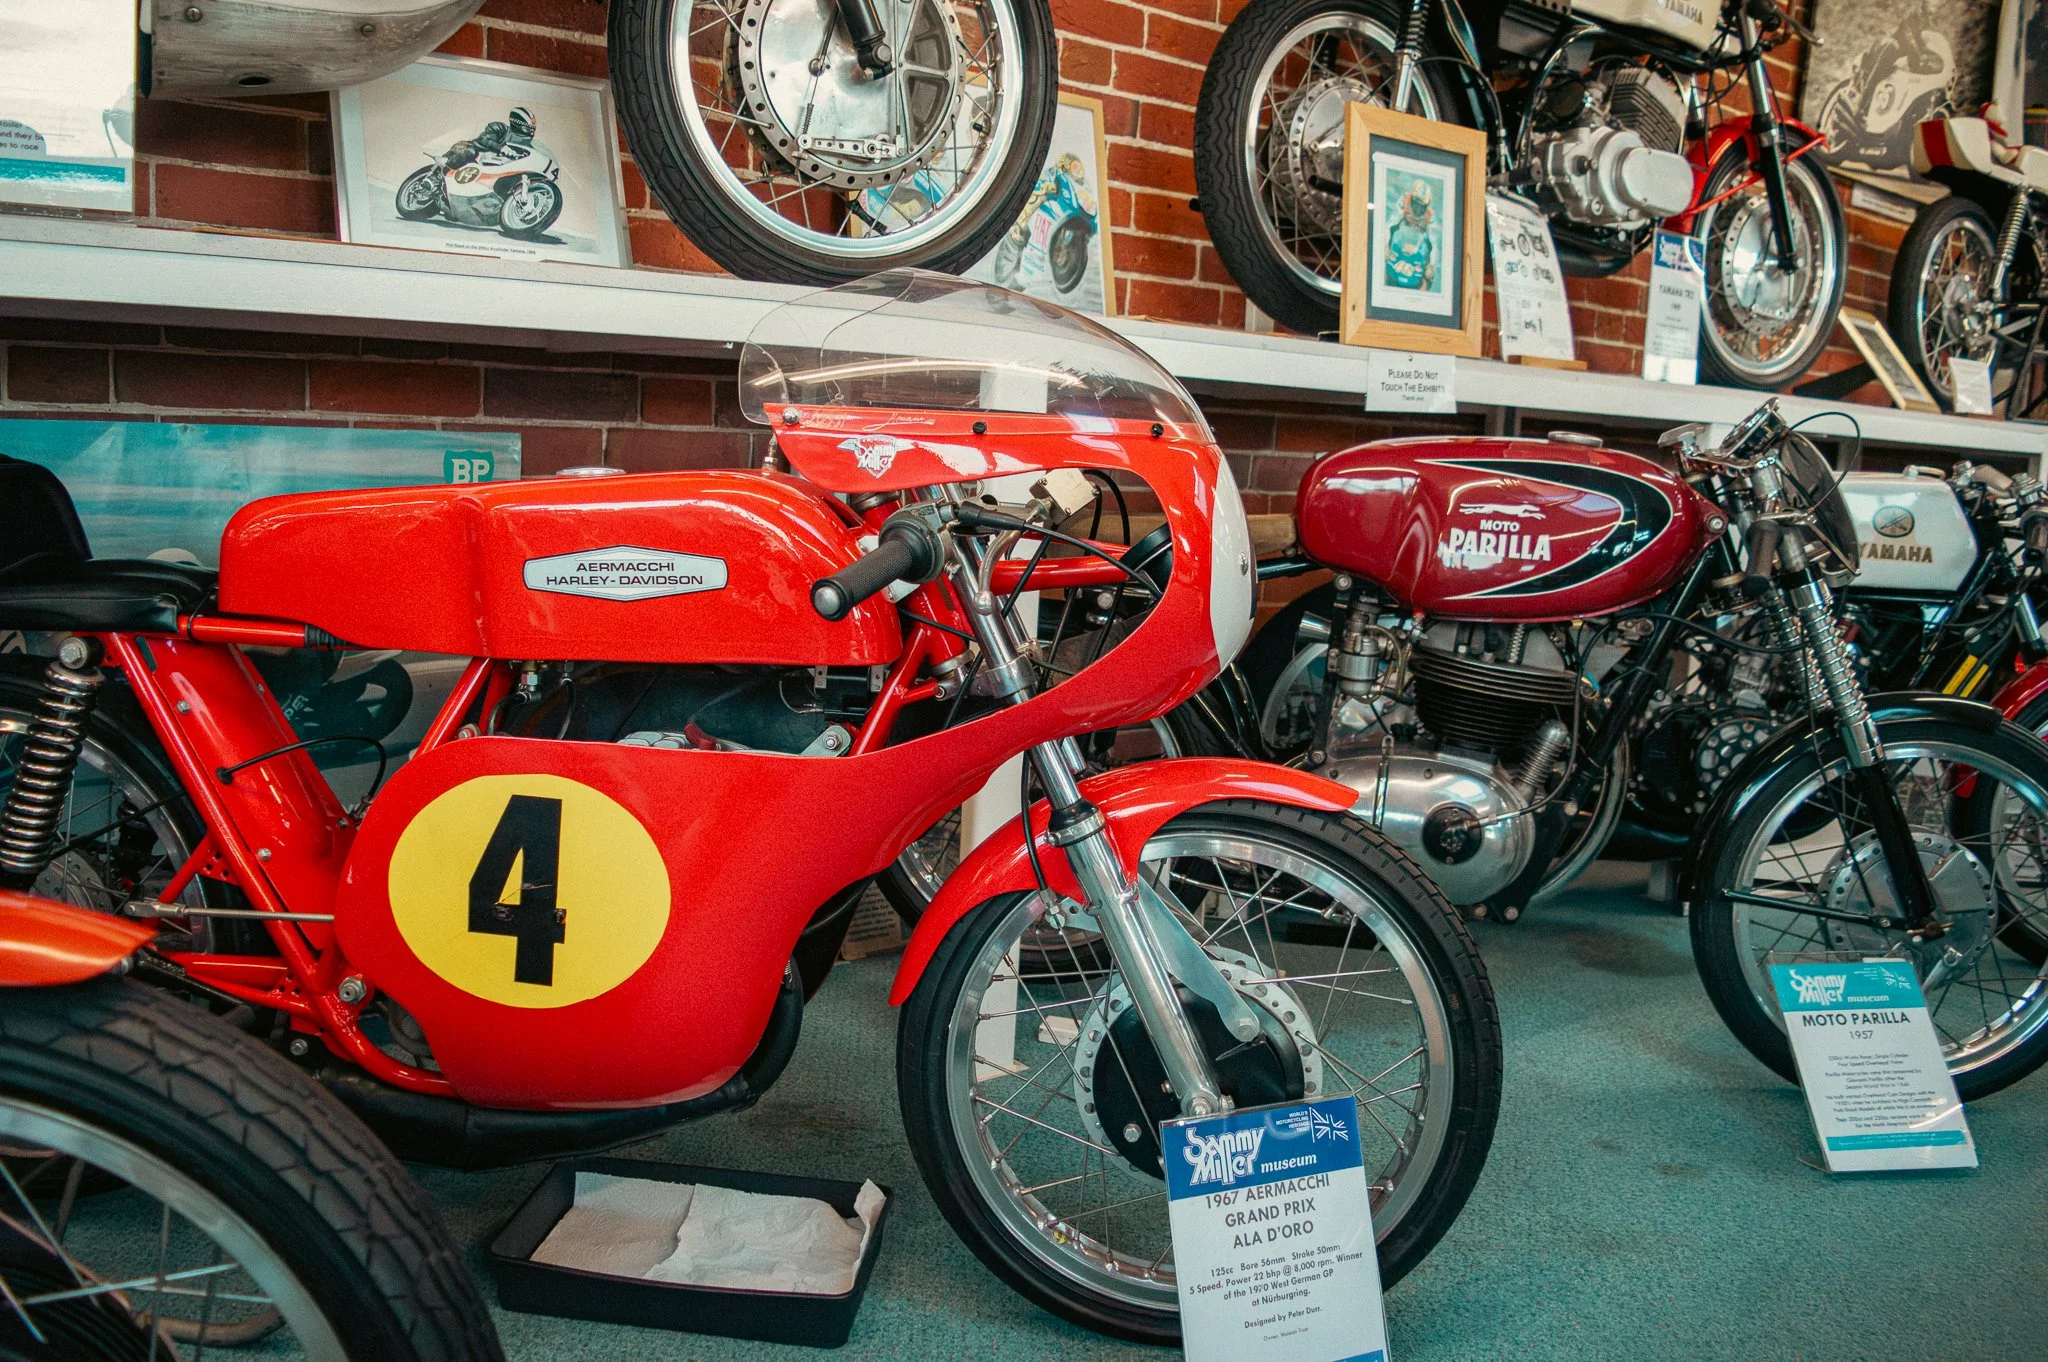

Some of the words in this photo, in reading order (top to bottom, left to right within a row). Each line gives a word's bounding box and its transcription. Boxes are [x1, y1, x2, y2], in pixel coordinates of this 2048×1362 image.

[1380, 382, 1403, 392] TOUCH
[1404, 382, 1416, 392] THE
[1388, 369, 1412, 379] PLEASE
[1413, 370, 1424, 380] DO
[1425, 370, 1439, 380] NOT
[451, 458, 490, 484] BP
[1480, 519, 1520, 532] MOTO
[1449, 527, 1551, 561] PARILLA
[1860, 542, 1933, 563] YAMAHA
[576, 562, 675, 572] AERMACCHI
[468, 794, 567, 987] 4
[1798, 985, 1844, 1006] Miller
[1847, 995, 1889, 1003] museum
[1802, 1013, 1847, 1027] MOTO
[1851, 1012, 1911, 1025] PARILLA
[1849, 1030, 1874, 1039] 1957
[1183, 1127, 1267, 1164] Sammy
[1190, 1150, 1255, 1186] Miller
[1261, 1153, 1317, 1174] museum
[1205, 1190, 1239, 1209] 1967
[1245, 1173, 1330, 1202] AERMACCHI
[1225, 1205, 1279, 1228] GRAND
[1284, 1197, 1316, 1216] PRIX
[1233, 1231, 1263, 1249] ALA
[1267, 1220, 1314, 1242] D'ORO
[1189, 1286, 1195, 1295] 5
[1197, 1280, 1224, 1294] Speed.
[1225, 1276, 1251, 1287] Power
[1253, 1271, 1264, 1281] 22
[1266, 1268, 1281, 1279] bhp
[1283, 1264, 1292, 1276] @
[1336, 1251, 1363, 1263] Winner
[1211, 1267, 1234, 1278] 125cc
[1240, 1262, 1259, 1271] Bore
[1261, 1256, 1286, 1267] 56mm
[1292, 1249, 1315, 1260] Stroke
[1317, 1245, 1340, 1255] 50mm
[1223, 1290, 1231, 1300] of
[1233, 1289, 1247, 1298] the
[1270, 1280, 1289, 1290] West
[1291, 1273, 1321, 1285] German
[1322, 1268, 1334, 1278] GP
[1251, 1299, 1260, 1307] at
[1244, 1315, 1276, 1329] Designed
[1277, 1313, 1287, 1322] by
